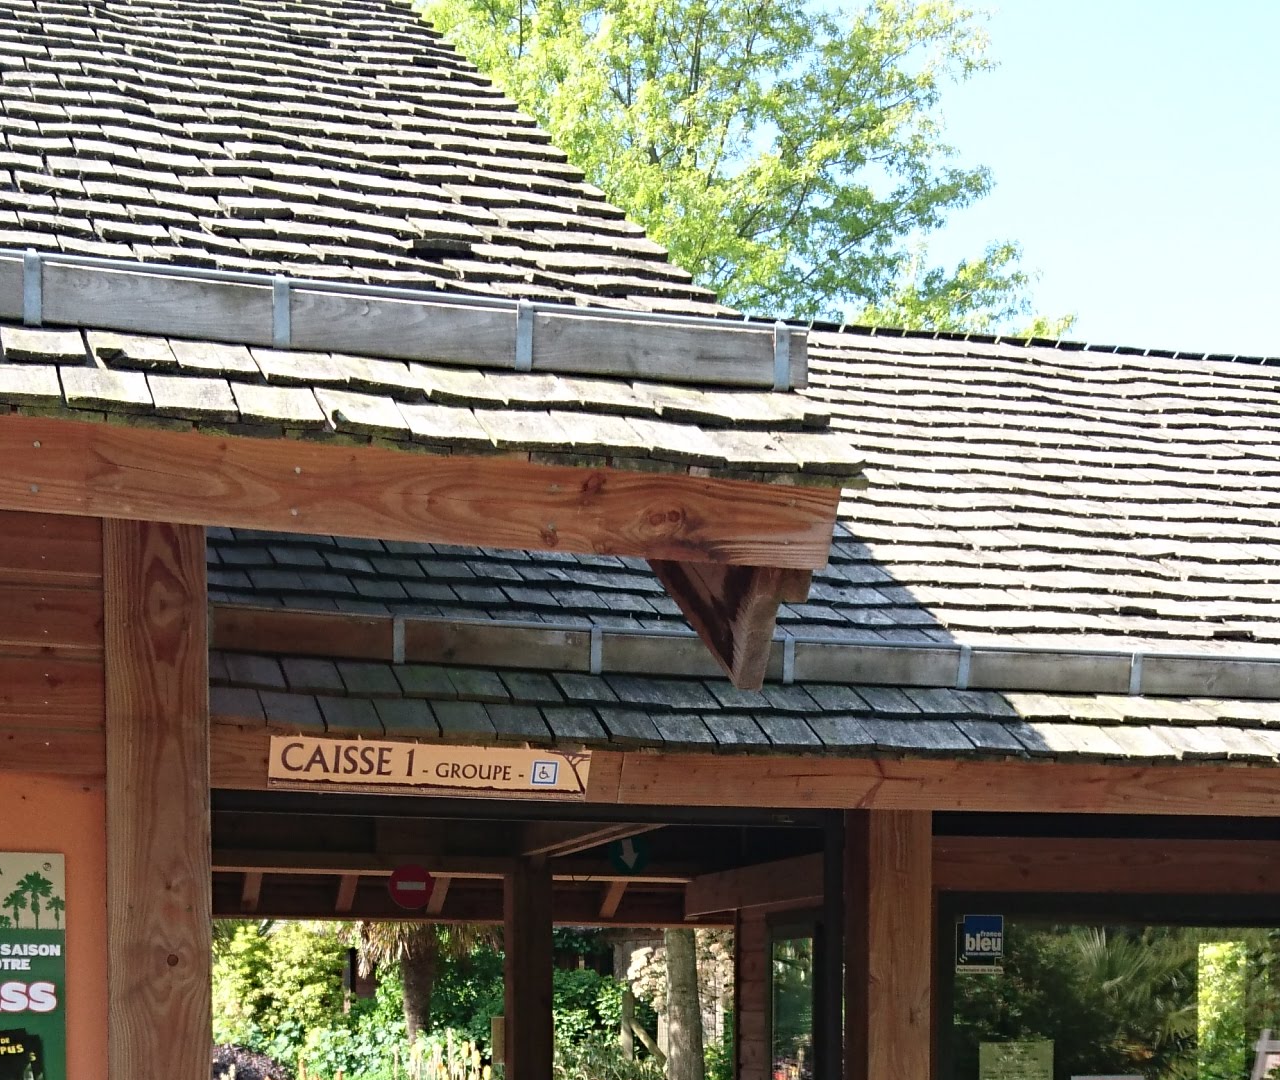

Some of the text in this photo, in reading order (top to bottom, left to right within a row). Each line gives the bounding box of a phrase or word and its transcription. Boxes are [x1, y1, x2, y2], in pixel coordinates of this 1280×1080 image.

[281, 742, 393, 777] CAISSE
[406, 748, 416, 777] 1
[435, 762, 512, 782] GROUPE
[965, 933, 1001, 951] bleu
[0, 944, 61, 957] SAISON
[0, 1037, 10, 1045] DE
